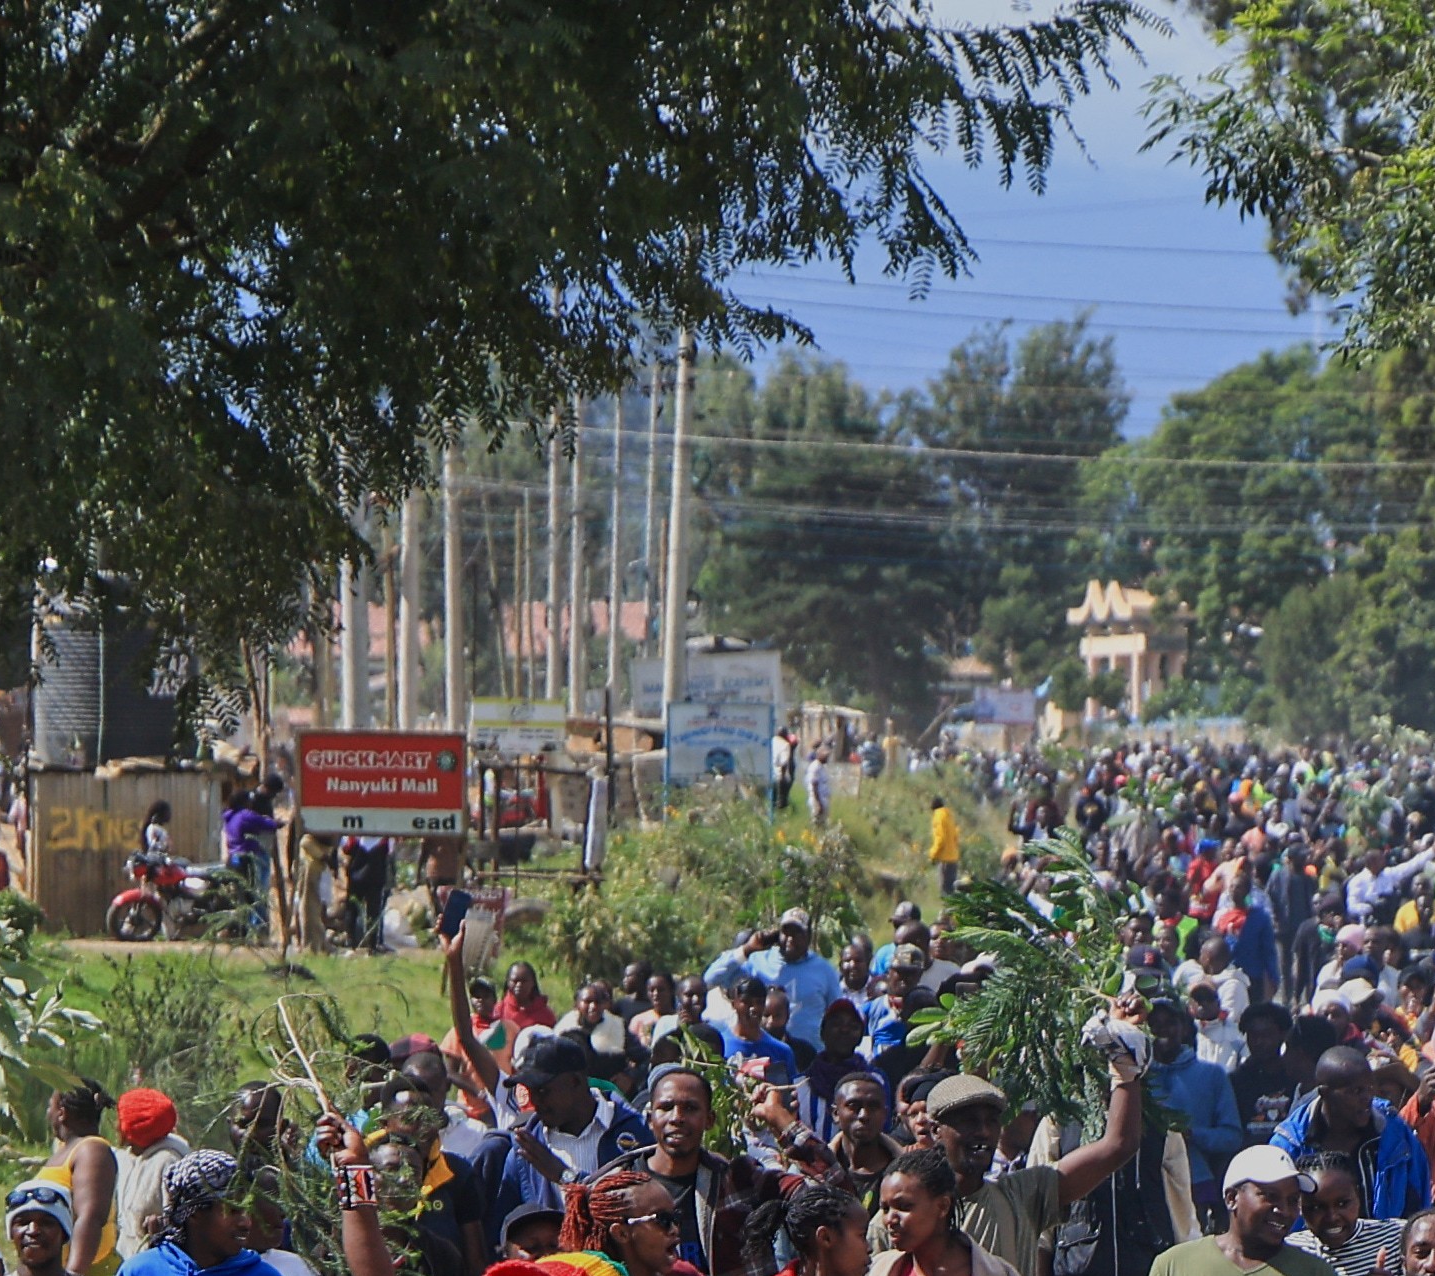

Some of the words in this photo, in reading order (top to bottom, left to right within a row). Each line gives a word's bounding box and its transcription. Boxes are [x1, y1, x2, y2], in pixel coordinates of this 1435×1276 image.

[305, 750, 432, 771] QUICKMART
[326, 777, 398, 797] Nanyuki
[401, 777, 438, 793] Mall
